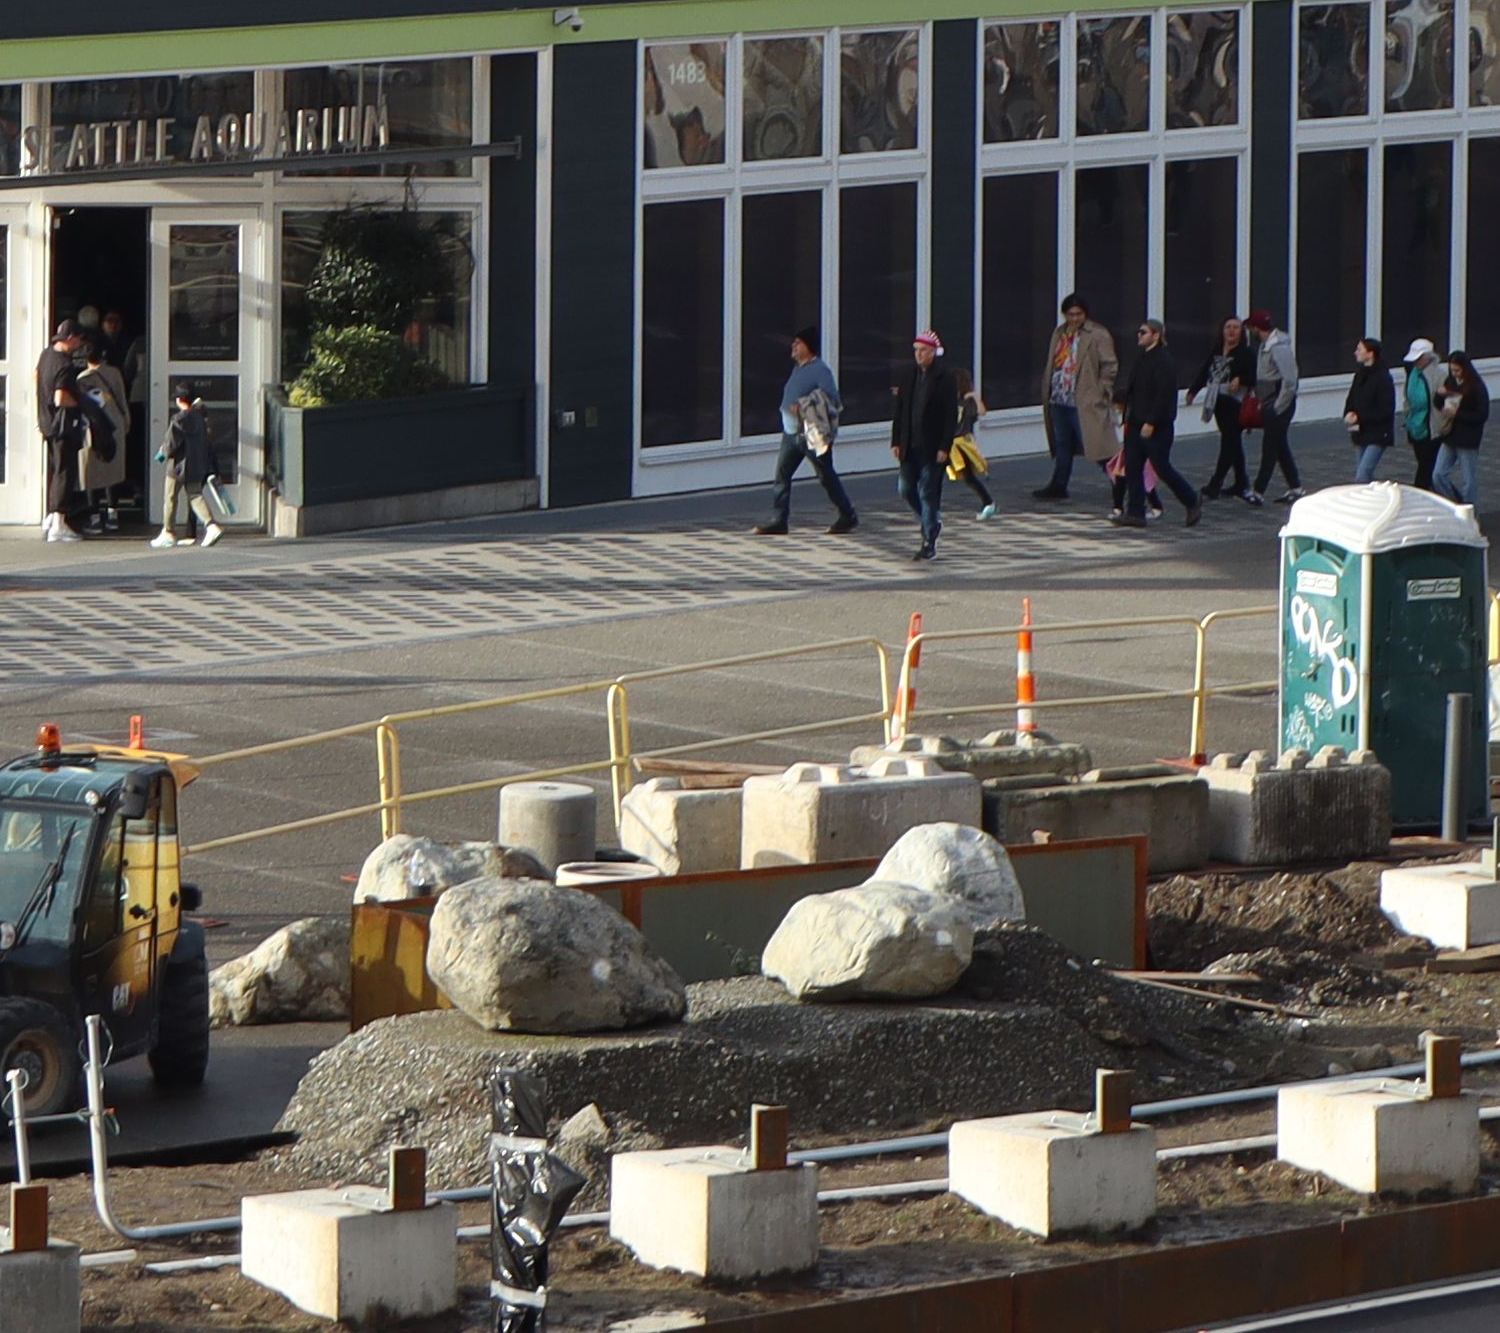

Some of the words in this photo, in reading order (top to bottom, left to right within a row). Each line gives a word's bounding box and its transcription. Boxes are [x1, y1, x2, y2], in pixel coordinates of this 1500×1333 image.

[668, 61, 707, 86] 1483
[19, 116, 176, 176] SEATTLE
[189, 105, 391, 161] AQUARIUM
